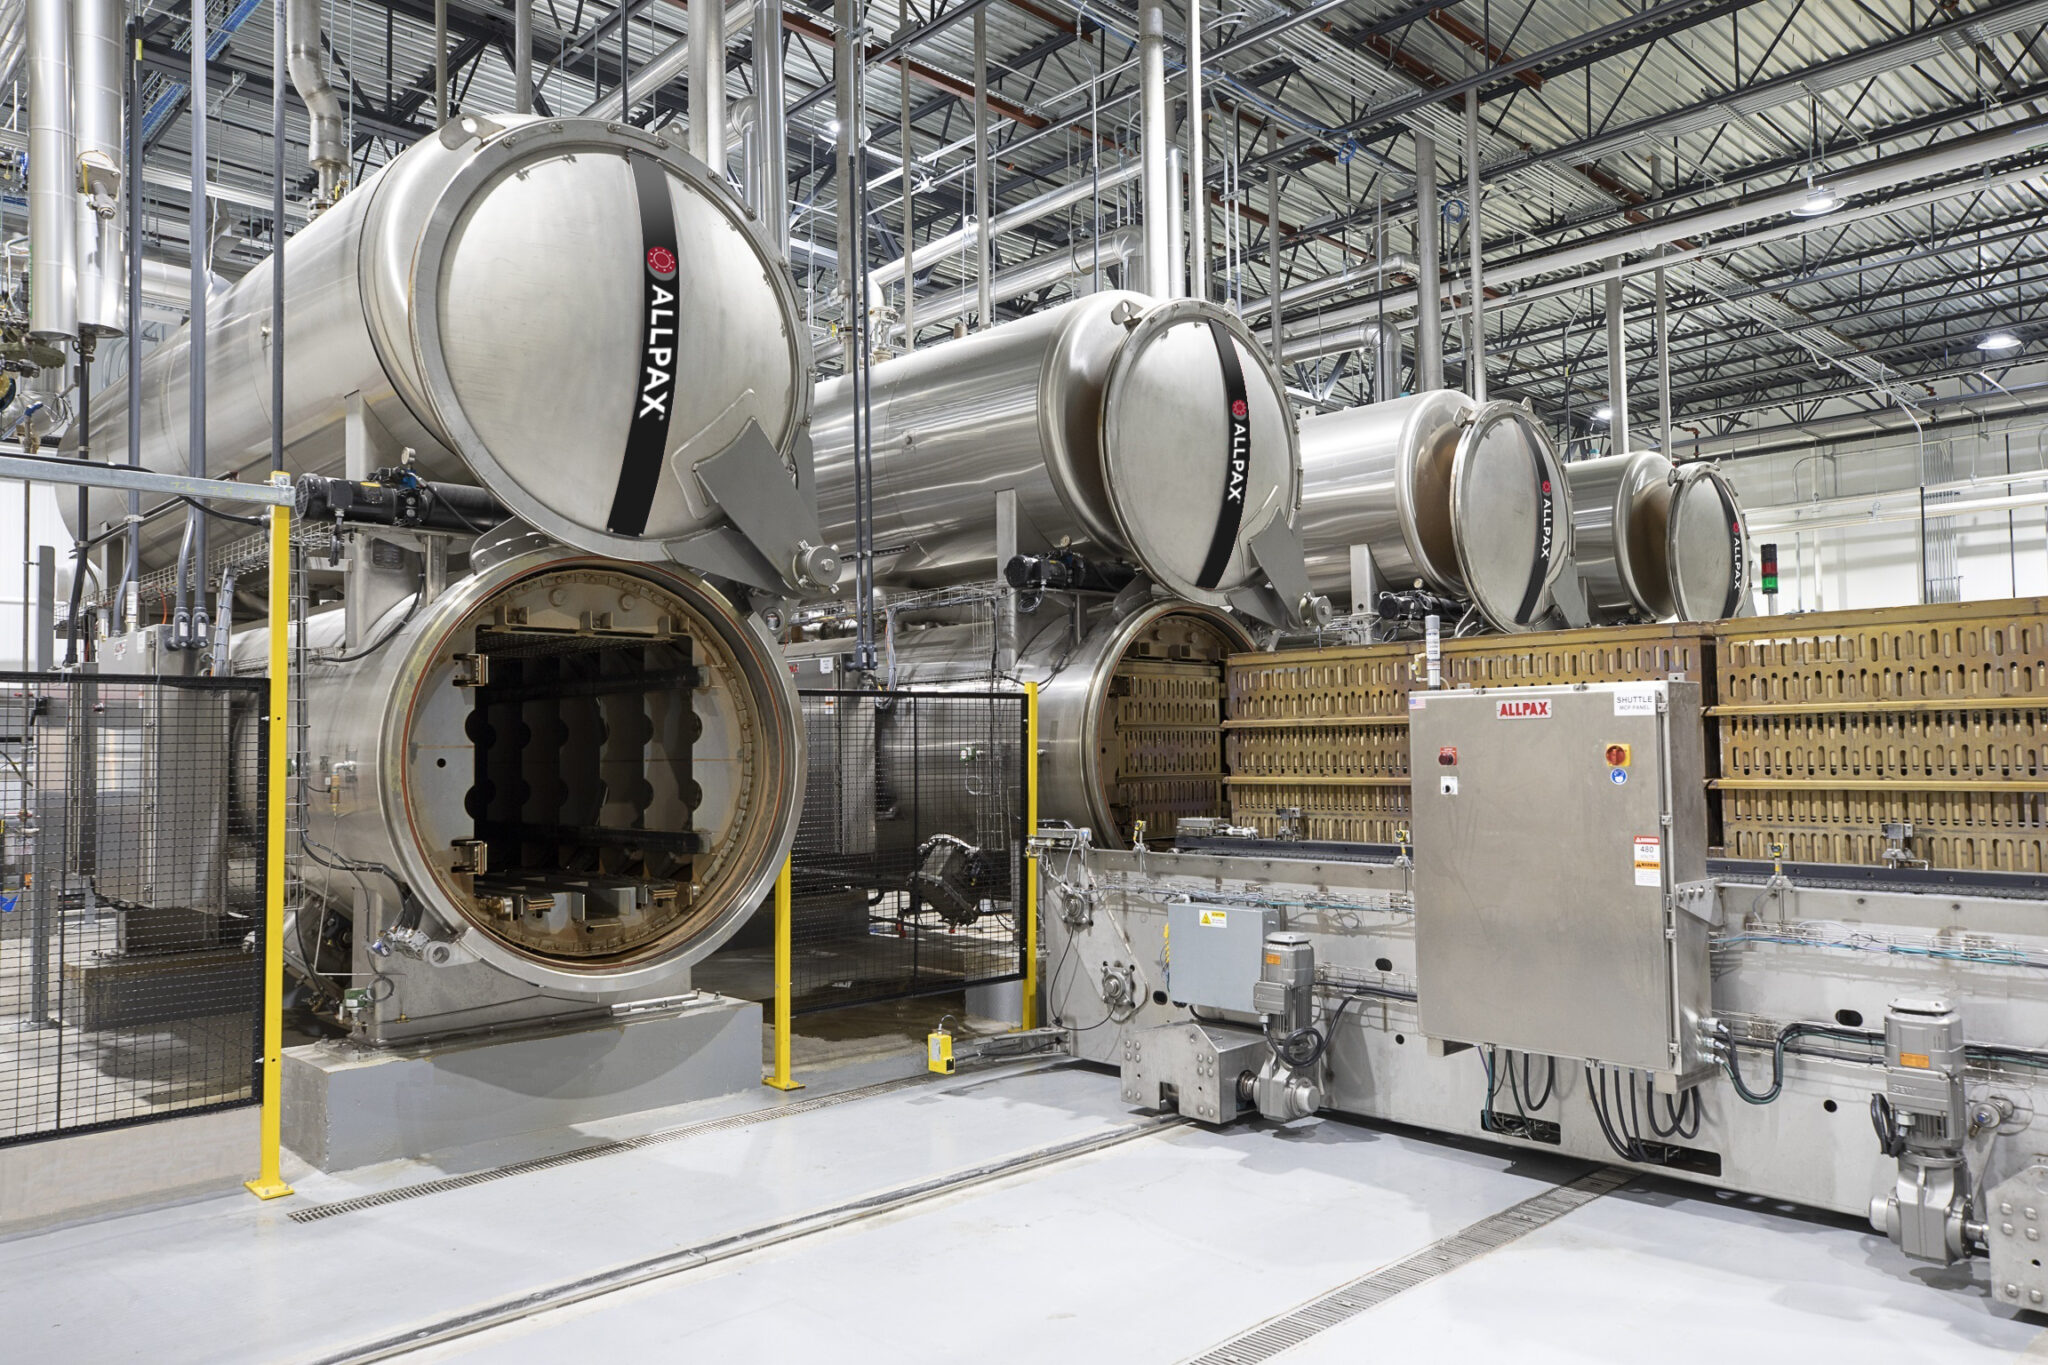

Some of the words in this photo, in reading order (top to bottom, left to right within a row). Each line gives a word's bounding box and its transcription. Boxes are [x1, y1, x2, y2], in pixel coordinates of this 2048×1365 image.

[639, 284, 674, 418] ALLPAX
[1228, 423, 1246, 500] ALLPAX
[1541, 498, 1551, 558] ALLPAX
[1733, 537, 1743, 590] ALLPAX
[1500, 701, 1548, 716] ALLPAX
[1616, 695, 1653, 703] SHUTTLE
[1640, 845, 1655, 853] 480
